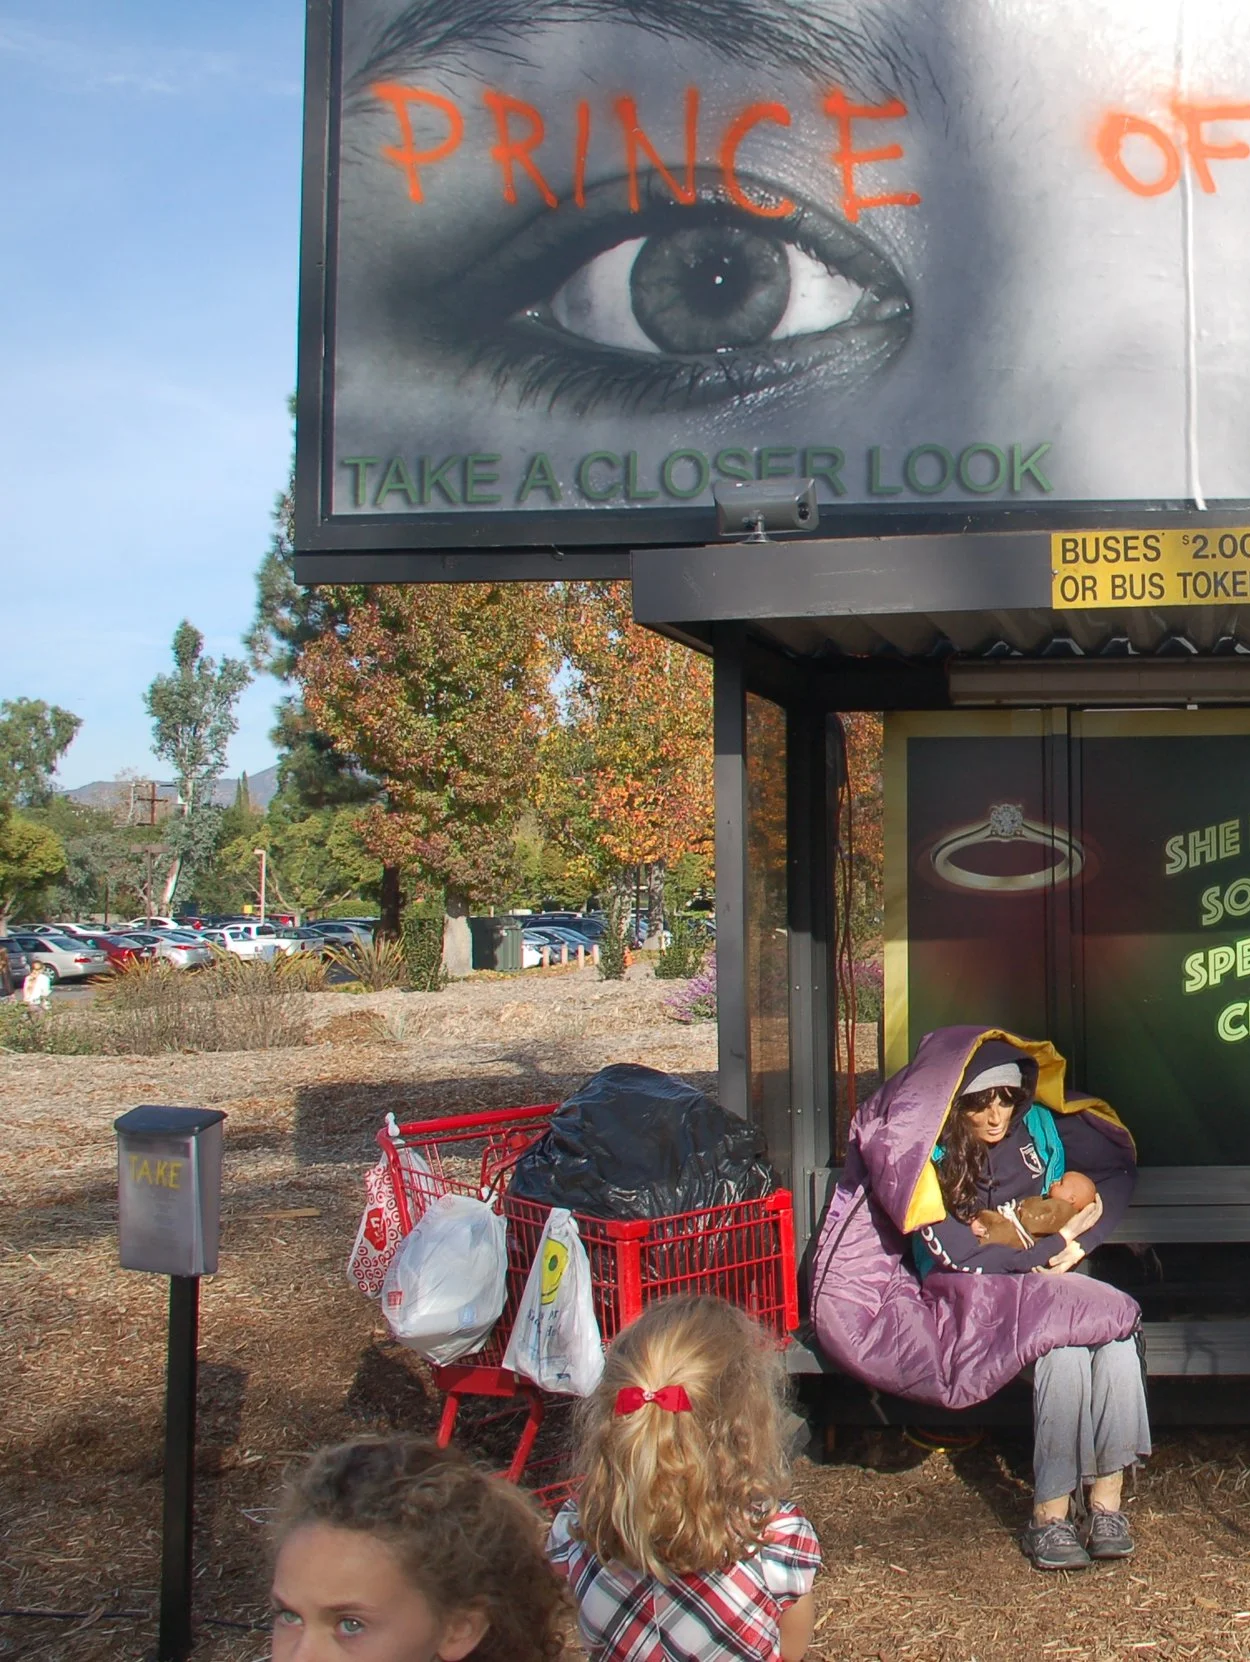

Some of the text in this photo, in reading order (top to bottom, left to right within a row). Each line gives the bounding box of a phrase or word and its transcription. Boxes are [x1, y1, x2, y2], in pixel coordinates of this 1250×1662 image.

[371, 82, 921, 223] PRINCE
[343, 442, 1054, 506] TAKE A CLOSER LOOK
[1061, 534, 1162, 565] BUSES
[1060, 574, 1098, 602] OR
[1111, 571, 1165, 600] BUS
[1165, 819, 1240, 875] SHE
[127, 1154, 184, 1190] TAKE
